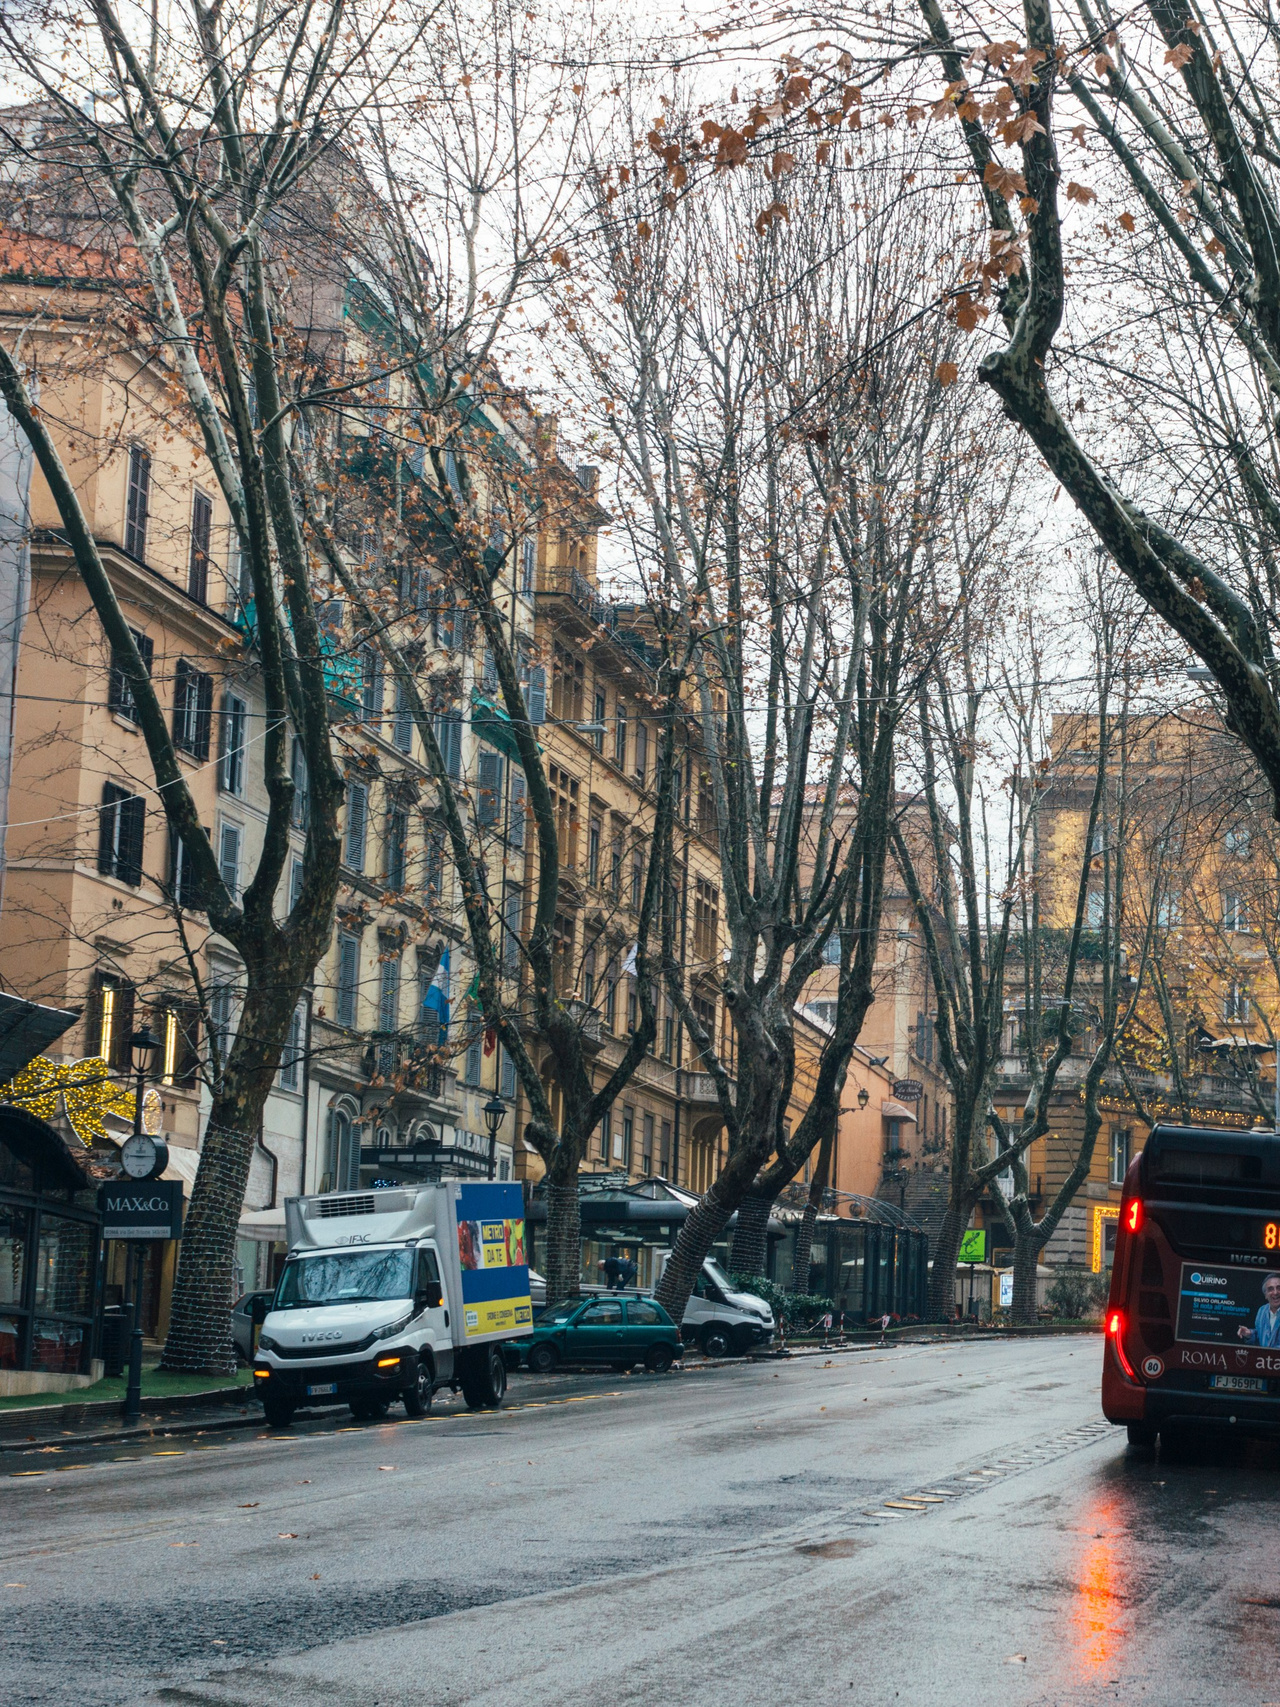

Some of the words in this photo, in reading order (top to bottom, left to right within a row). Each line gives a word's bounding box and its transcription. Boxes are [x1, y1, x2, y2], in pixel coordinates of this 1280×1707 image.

[137, 1168, 142, 1176] 6
[482, 1224, 504, 1240] METRO
[349, 1234, 371, 1244] IFAC
[487, 1249, 495, 1263] DA
[496, 1248, 503, 1263] TE
[1230, 1254, 1267, 1264] IVECO
[1191, 1272, 1227, 1285] QUIRINO
[302, 1330, 342, 1342] IVECO
[1181, 1350, 1227, 1368] ROMA
[1147, 1363, 1158, 1372] 80
